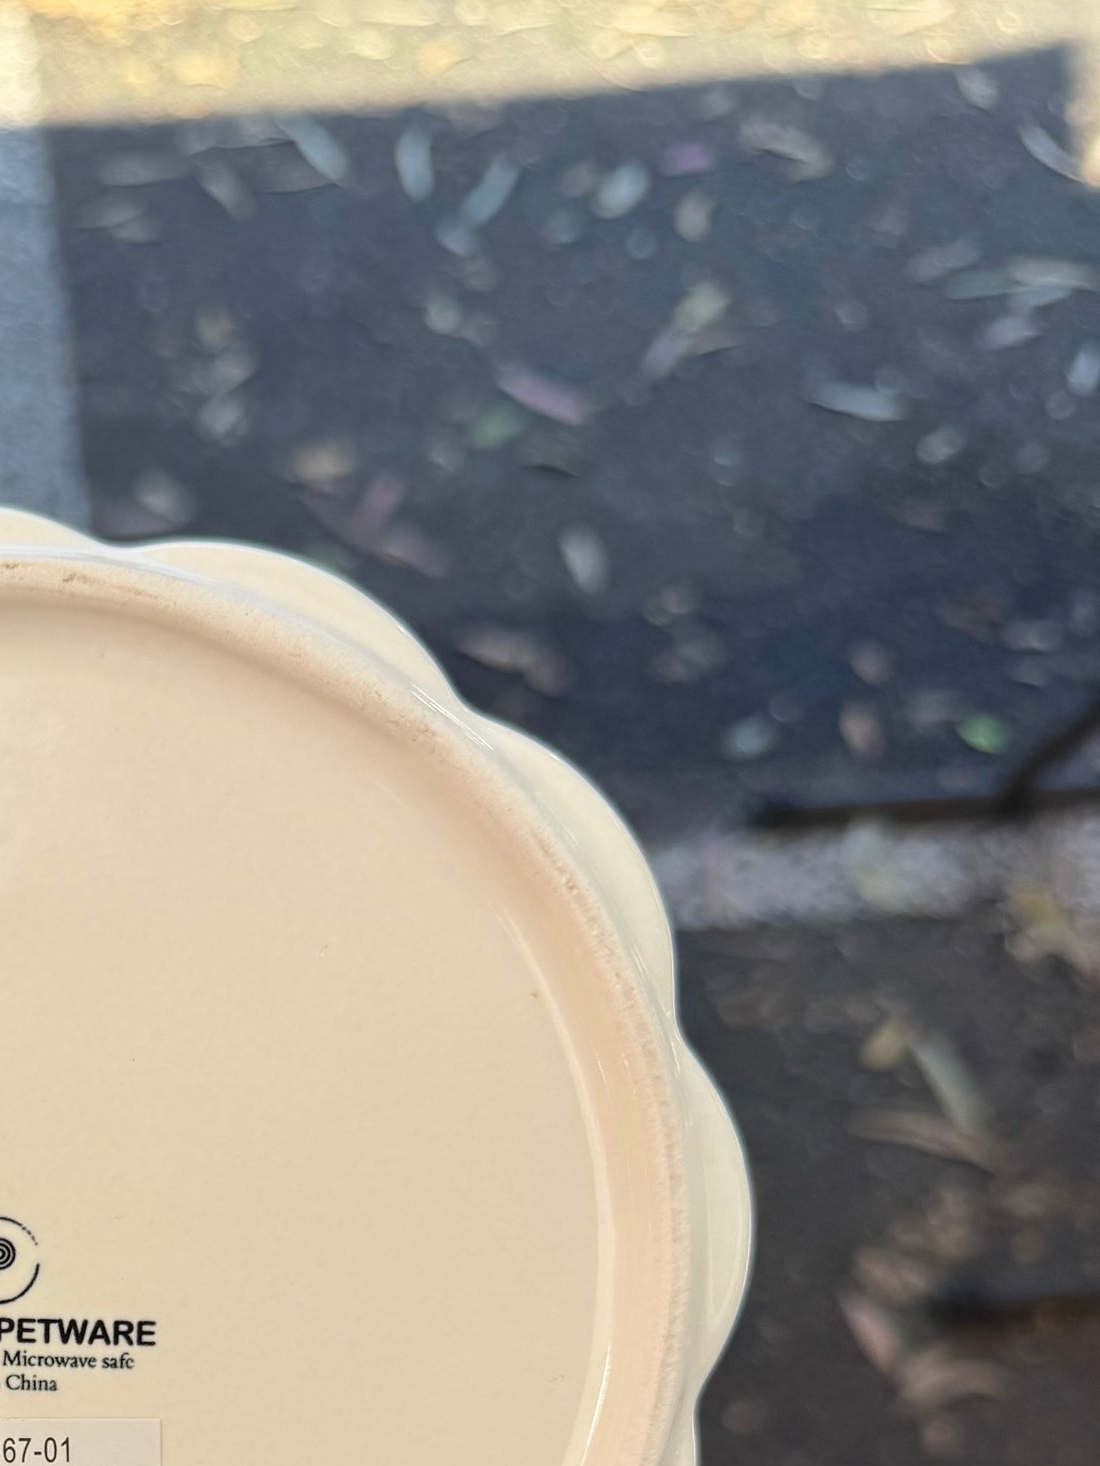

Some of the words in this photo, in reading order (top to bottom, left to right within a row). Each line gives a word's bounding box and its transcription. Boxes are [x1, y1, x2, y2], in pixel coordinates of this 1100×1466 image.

[2, 1350, 97, 1369] Microwave
[101, 1352, 135, 1370] safe
[5, 1374, 58, 1392] China
